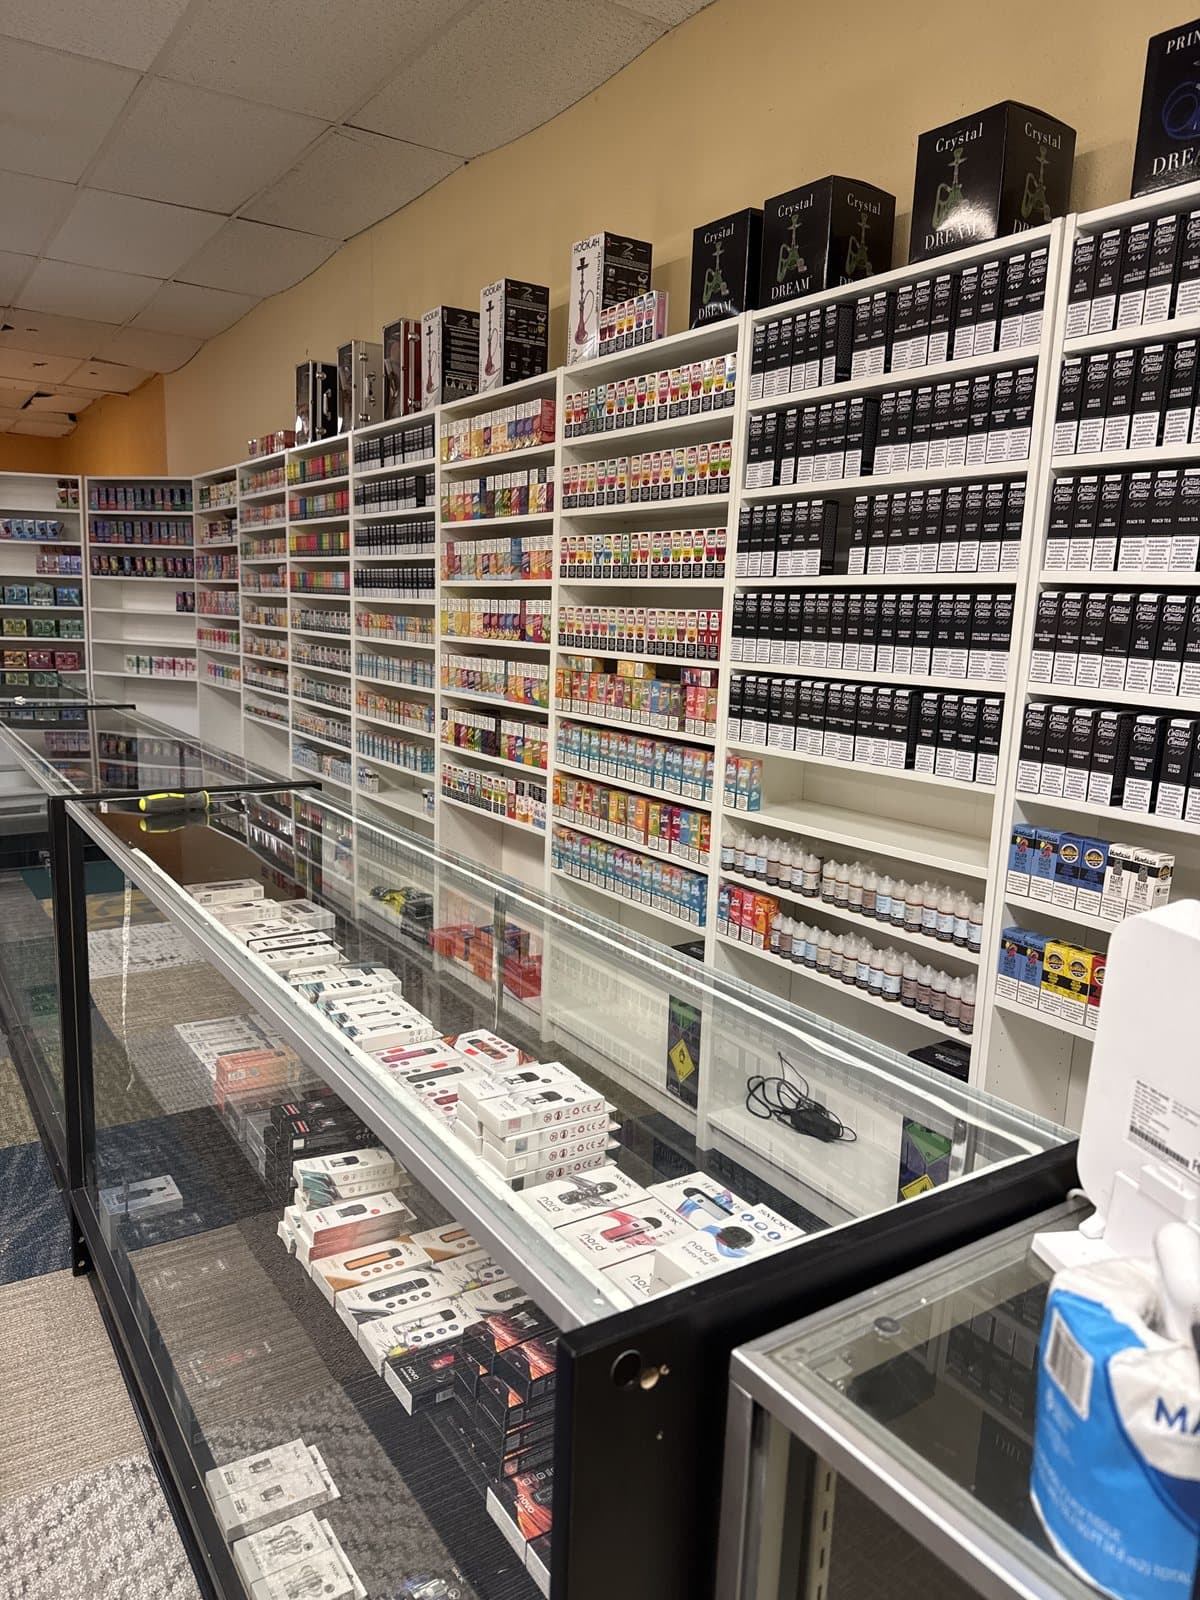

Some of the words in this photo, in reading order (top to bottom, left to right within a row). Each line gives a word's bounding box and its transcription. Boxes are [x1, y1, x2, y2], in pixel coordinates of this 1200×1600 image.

[936, 122, 983, 152] Crystal
[1024, 122, 1061, 150] Crystal
[778, 194, 814, 218] Crystal
[847, 192, 881, 216] Crystal
[704, 223, 735, 244] Crystal
[770, 276, 810, 300] DREAM
[698, 300, 732, 320] DREAM
[405, 1365, 420, 1381] novo
[516, 1493, 535, 1514] novo
